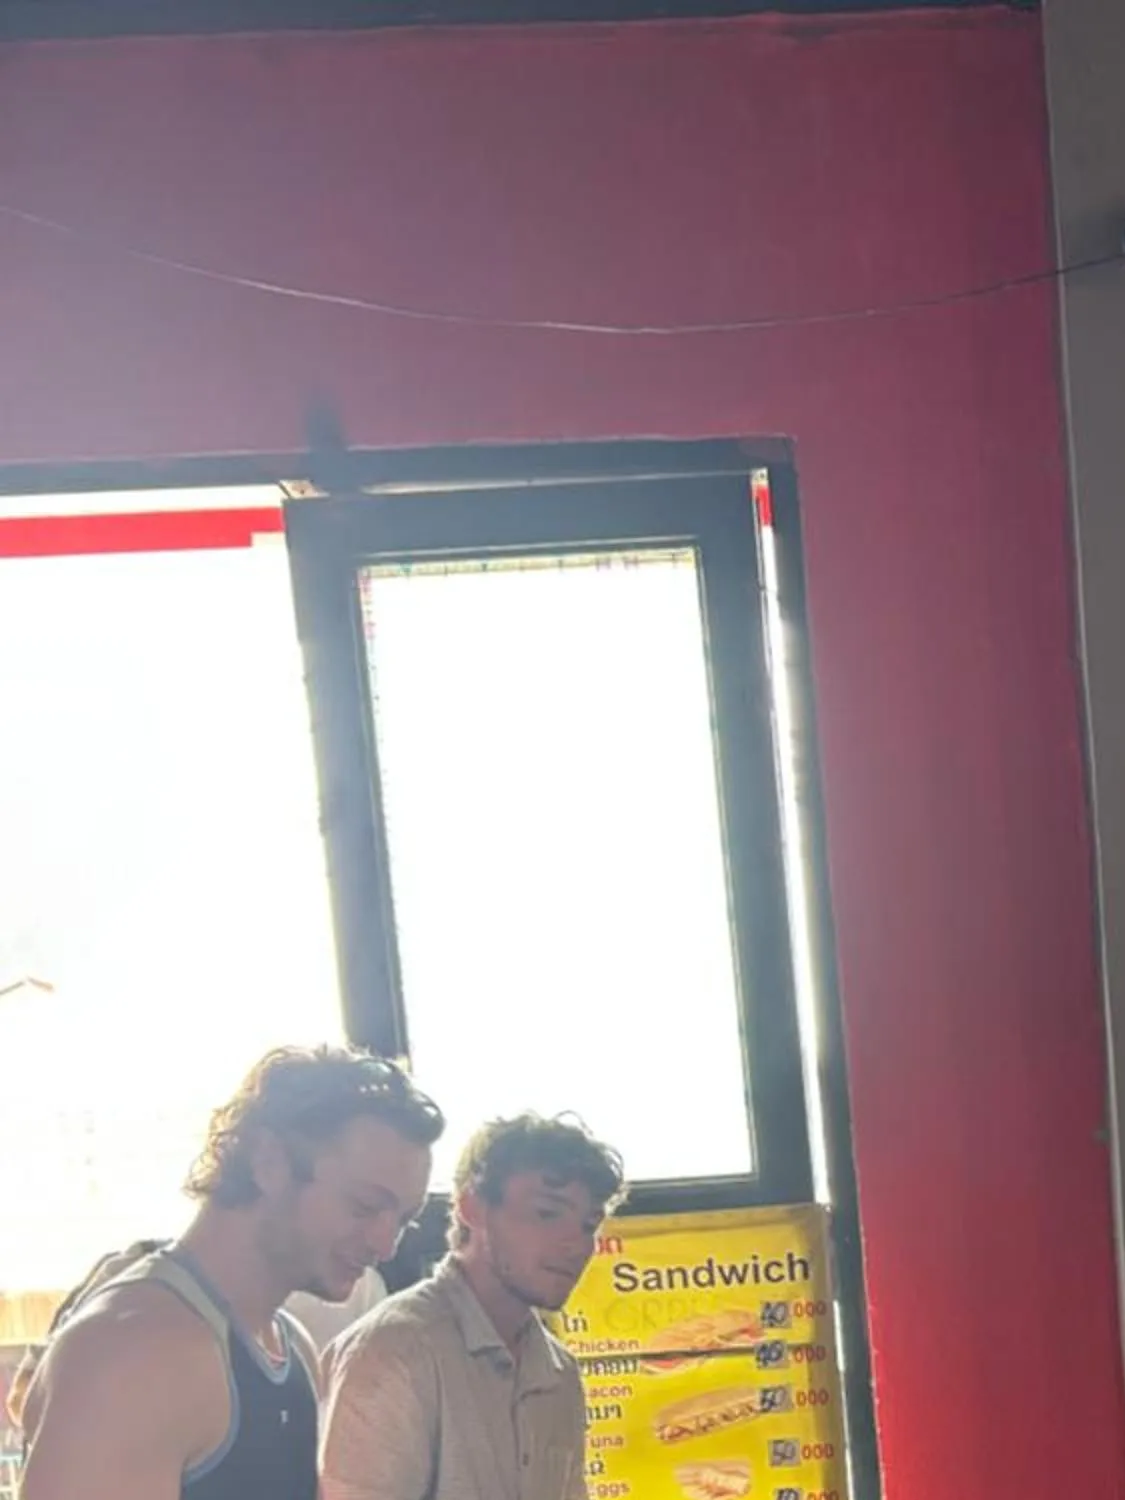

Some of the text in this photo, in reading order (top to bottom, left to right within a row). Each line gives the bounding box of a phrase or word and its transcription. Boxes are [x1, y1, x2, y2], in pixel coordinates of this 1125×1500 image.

[613, 1252, 810, 1293] Sandwich
[566, 1338, 640, 1353] Chicken
[587, 1385, 633, 1398] acon
[587, 1435, 625, 1449] una
[590, 1482, 630, 1499] ggs
